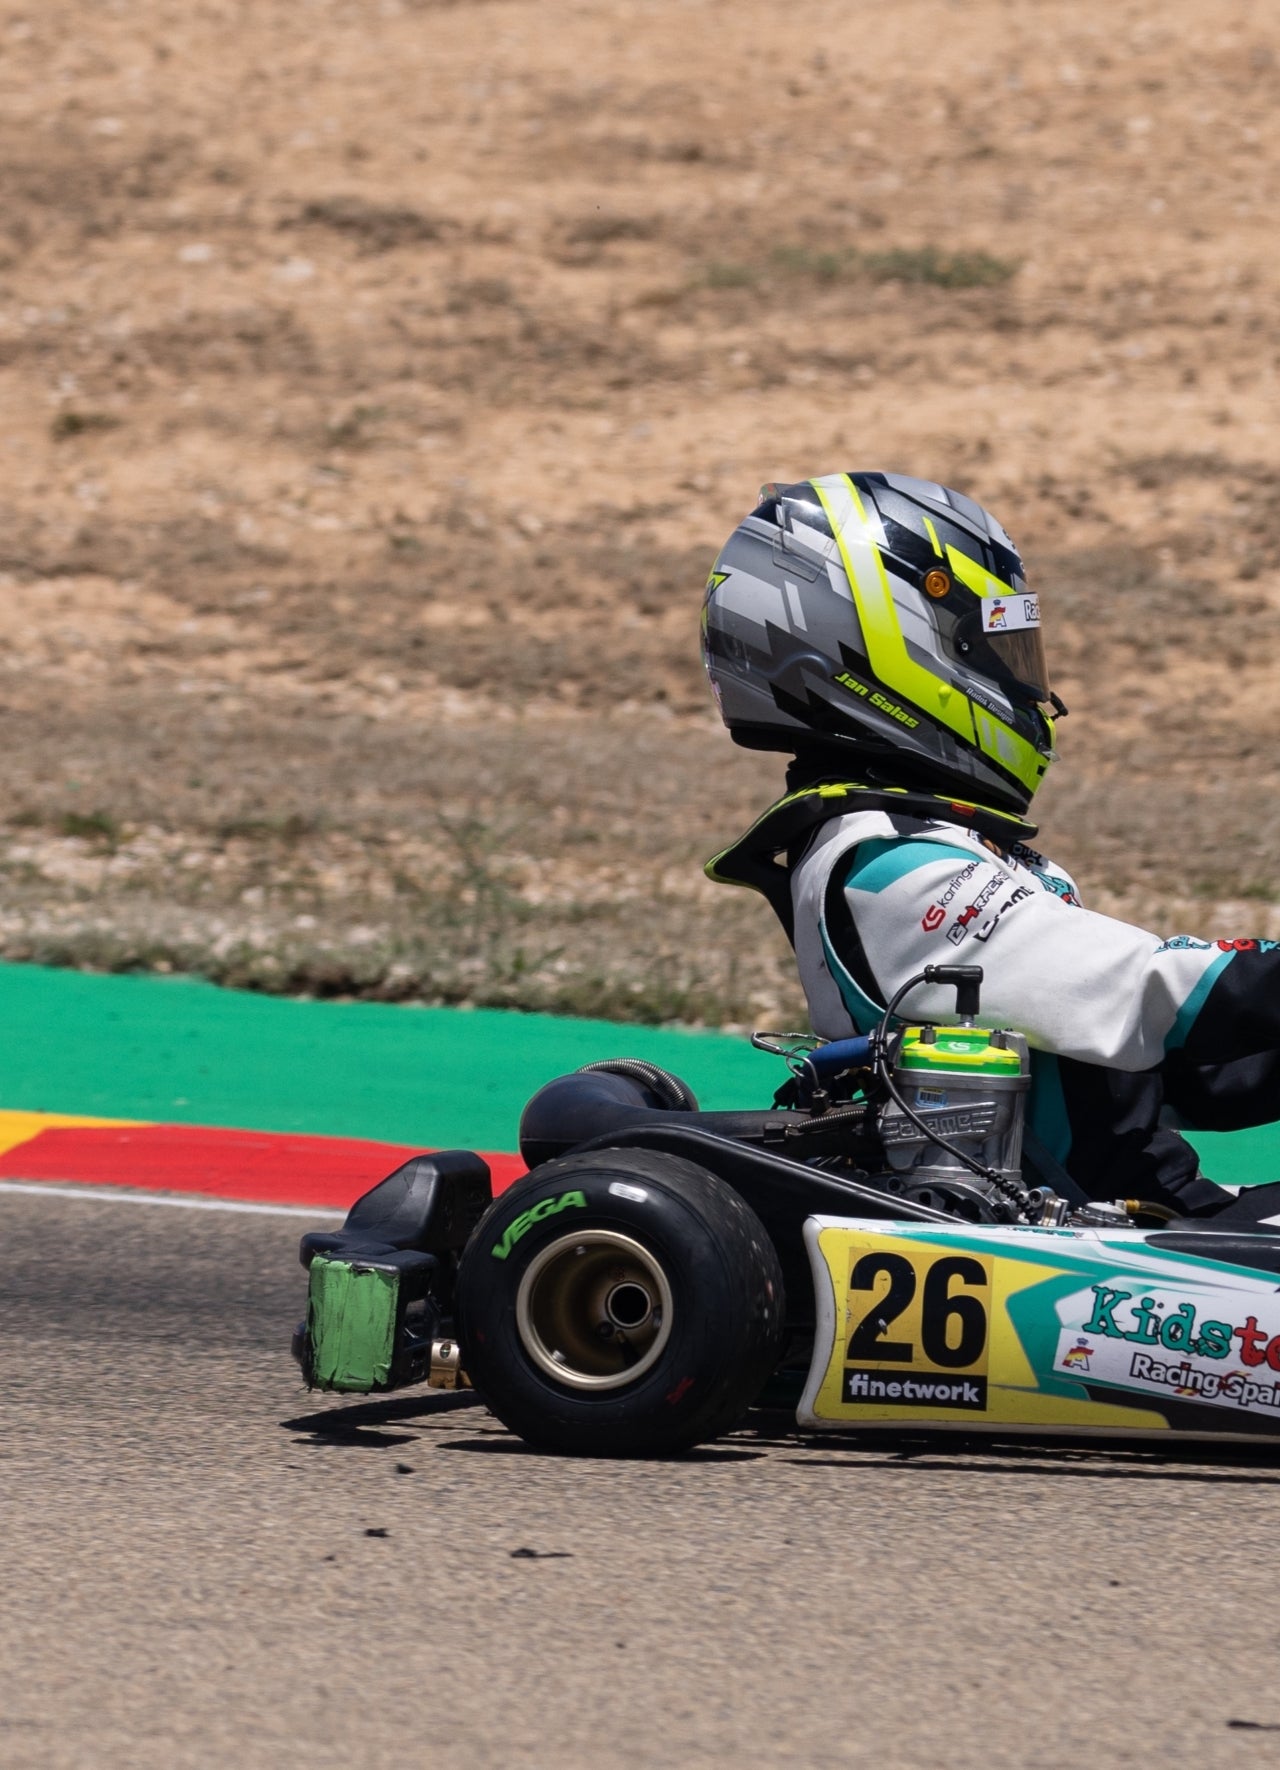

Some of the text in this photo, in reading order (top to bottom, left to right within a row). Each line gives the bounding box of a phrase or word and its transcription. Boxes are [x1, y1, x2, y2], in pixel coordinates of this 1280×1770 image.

[834, 672, 920, 729] Jan Salas
[491, 1190, 588, 1261] VEGA
[846, 1252, 988, 1369] 26
[849, 1374, 980, 1403] finetwork
[1130, 1352, 1221, 1399] Racing
